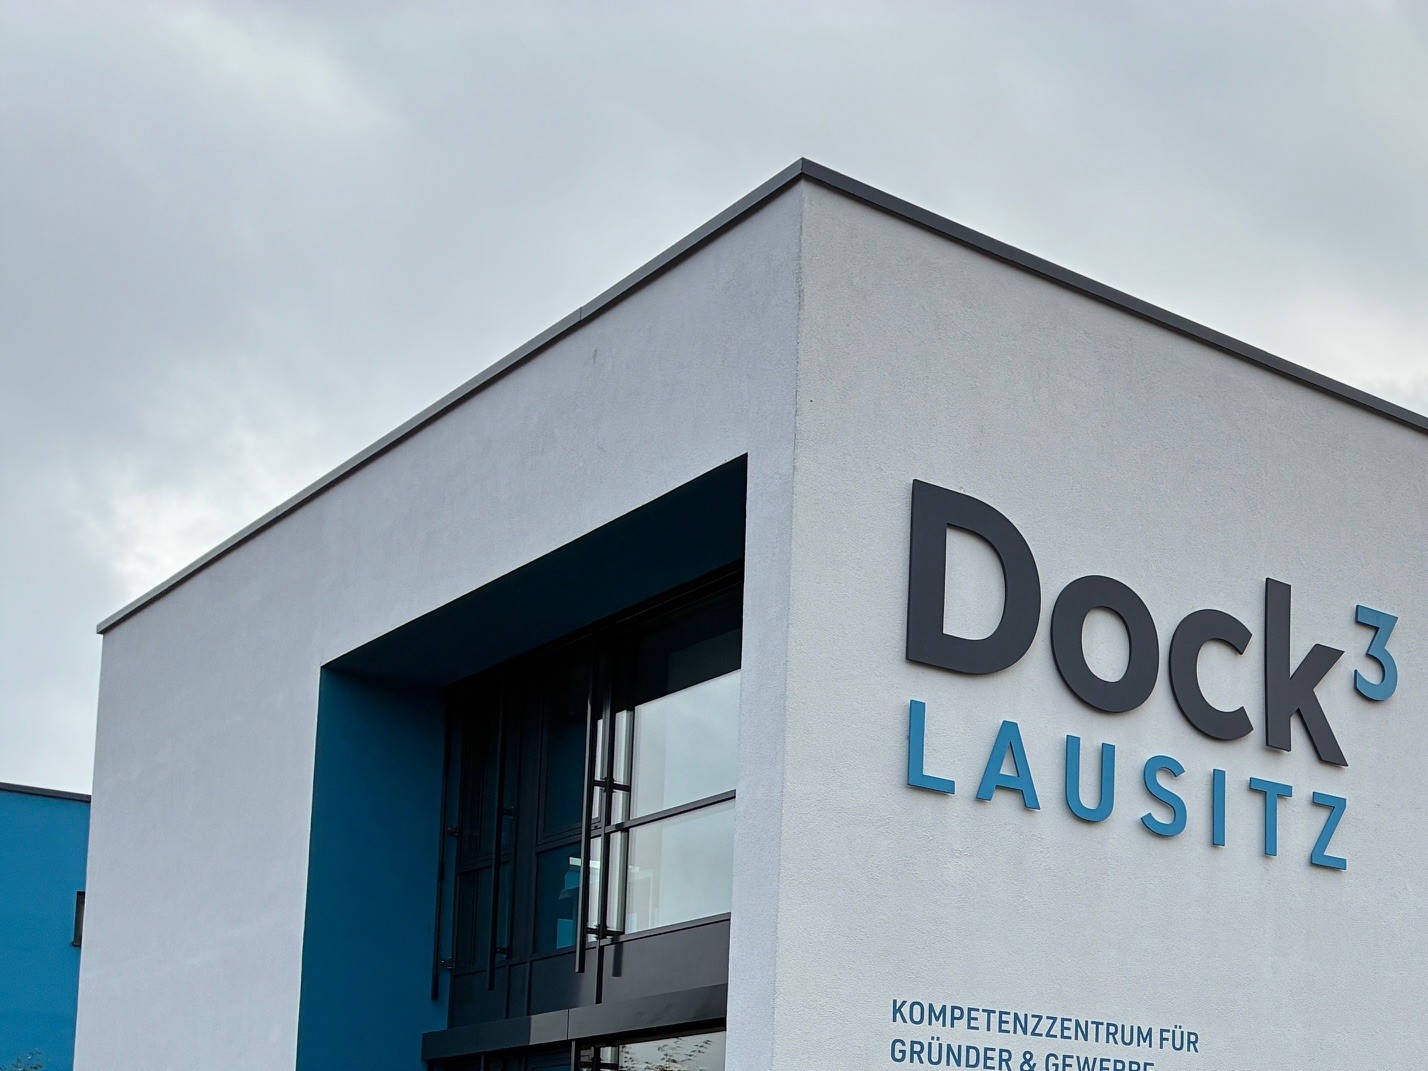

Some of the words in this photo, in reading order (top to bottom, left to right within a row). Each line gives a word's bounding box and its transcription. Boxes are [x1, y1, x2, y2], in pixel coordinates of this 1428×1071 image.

[905, 700, 1347, 872] LAUSITZ
[892, 999, 1153, 1048] KOMPETENZZENTRUM
[1159, 1025, 1199, 1053] FÜR
[890, 1037, 1012, 1071] GRÜNDER
